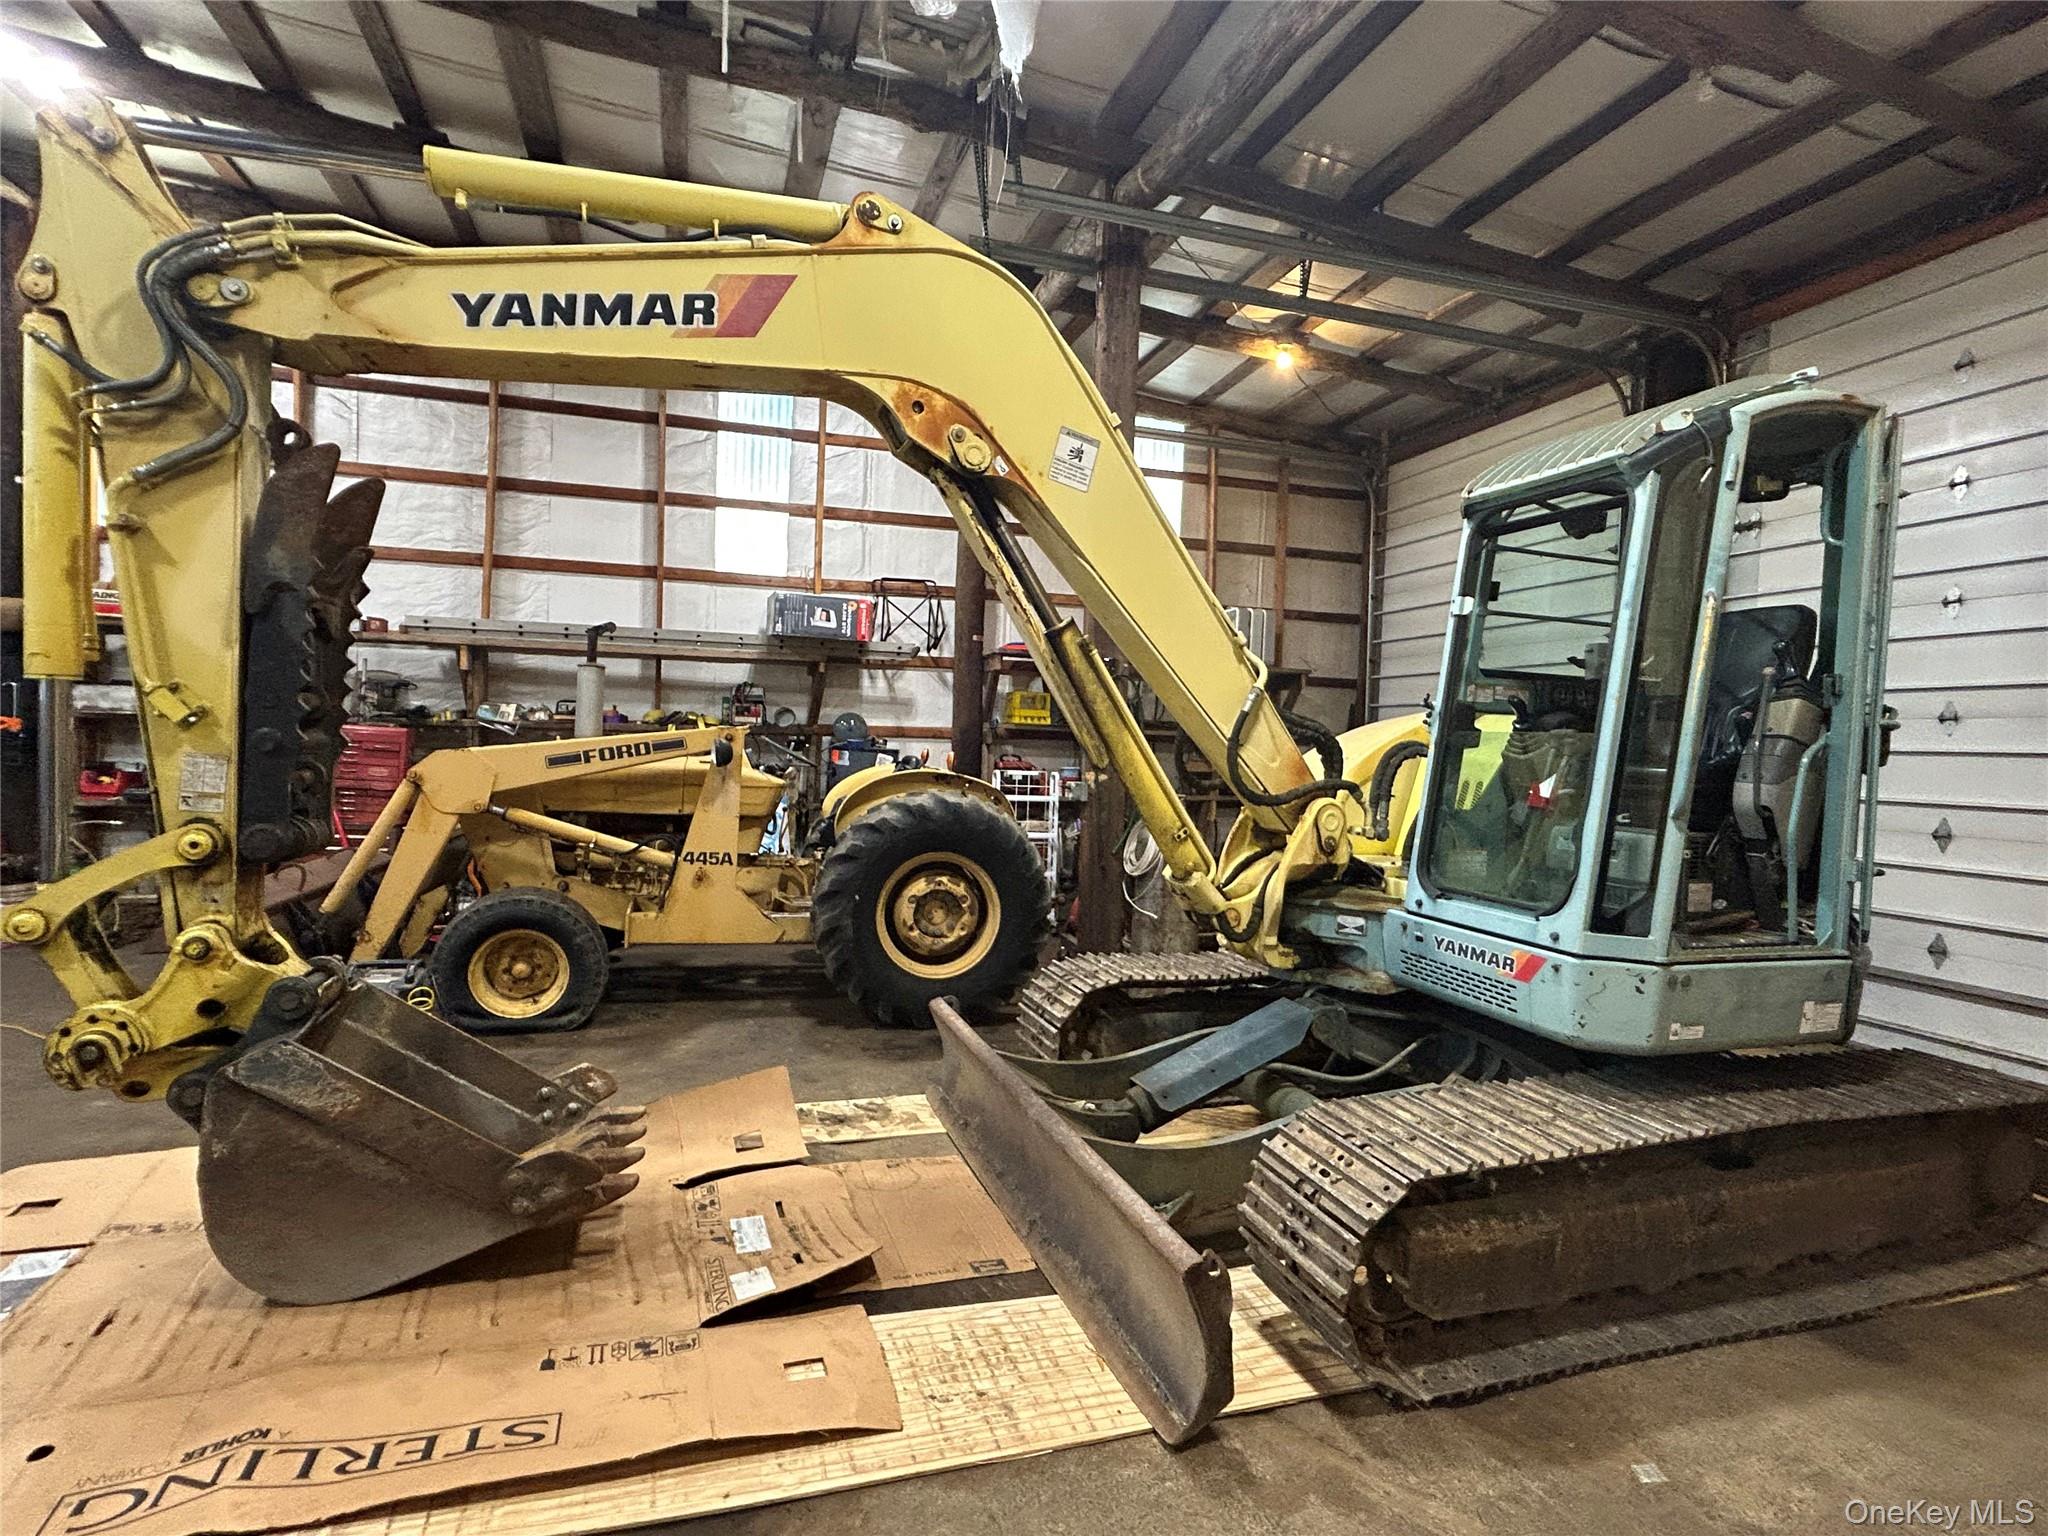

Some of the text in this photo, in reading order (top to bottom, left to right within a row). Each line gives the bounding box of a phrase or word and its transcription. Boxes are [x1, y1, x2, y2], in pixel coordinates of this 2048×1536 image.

[452, 293, 717, 327] YANMAR
[582, 742, 652, 764] FORD
[682, 851, 734, 866] 445A
[1433, 935, 1516, 973] YANMAR
[706, 1257, 731, 1312] STERLING
[178, 1427, 273, 1464] KOHLER
[65, 1418, 550, 1534] STERLING
